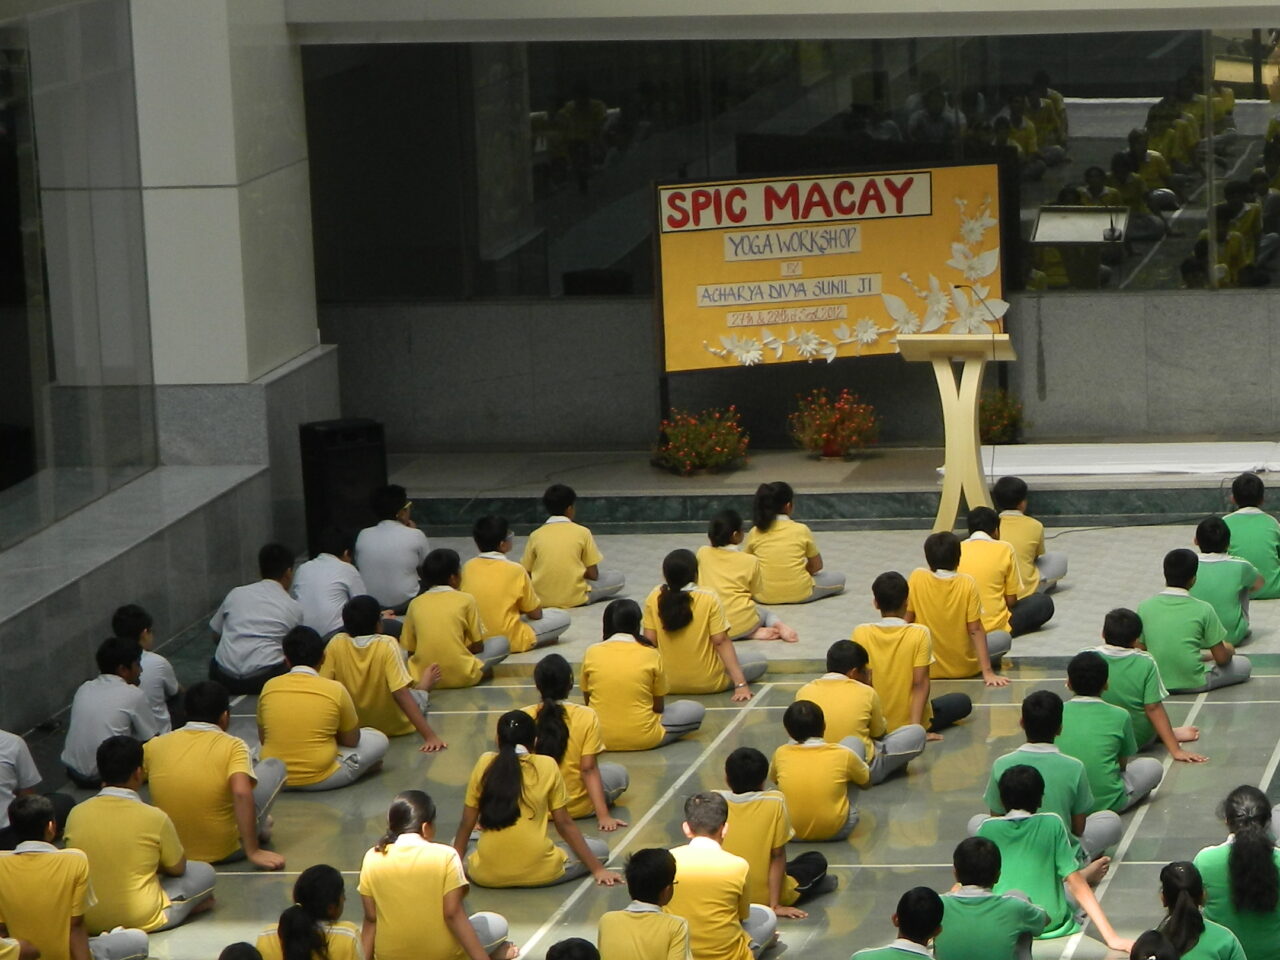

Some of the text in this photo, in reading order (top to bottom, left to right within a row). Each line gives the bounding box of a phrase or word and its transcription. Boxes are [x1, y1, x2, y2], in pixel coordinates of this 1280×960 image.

[667, 177, 914, 229] SPIC MACAY
[728, 227, 856, 256] YOGA WORKSHOP
[702, 277, 872, 302] ACHARYA DIVYA SUNIL JI
